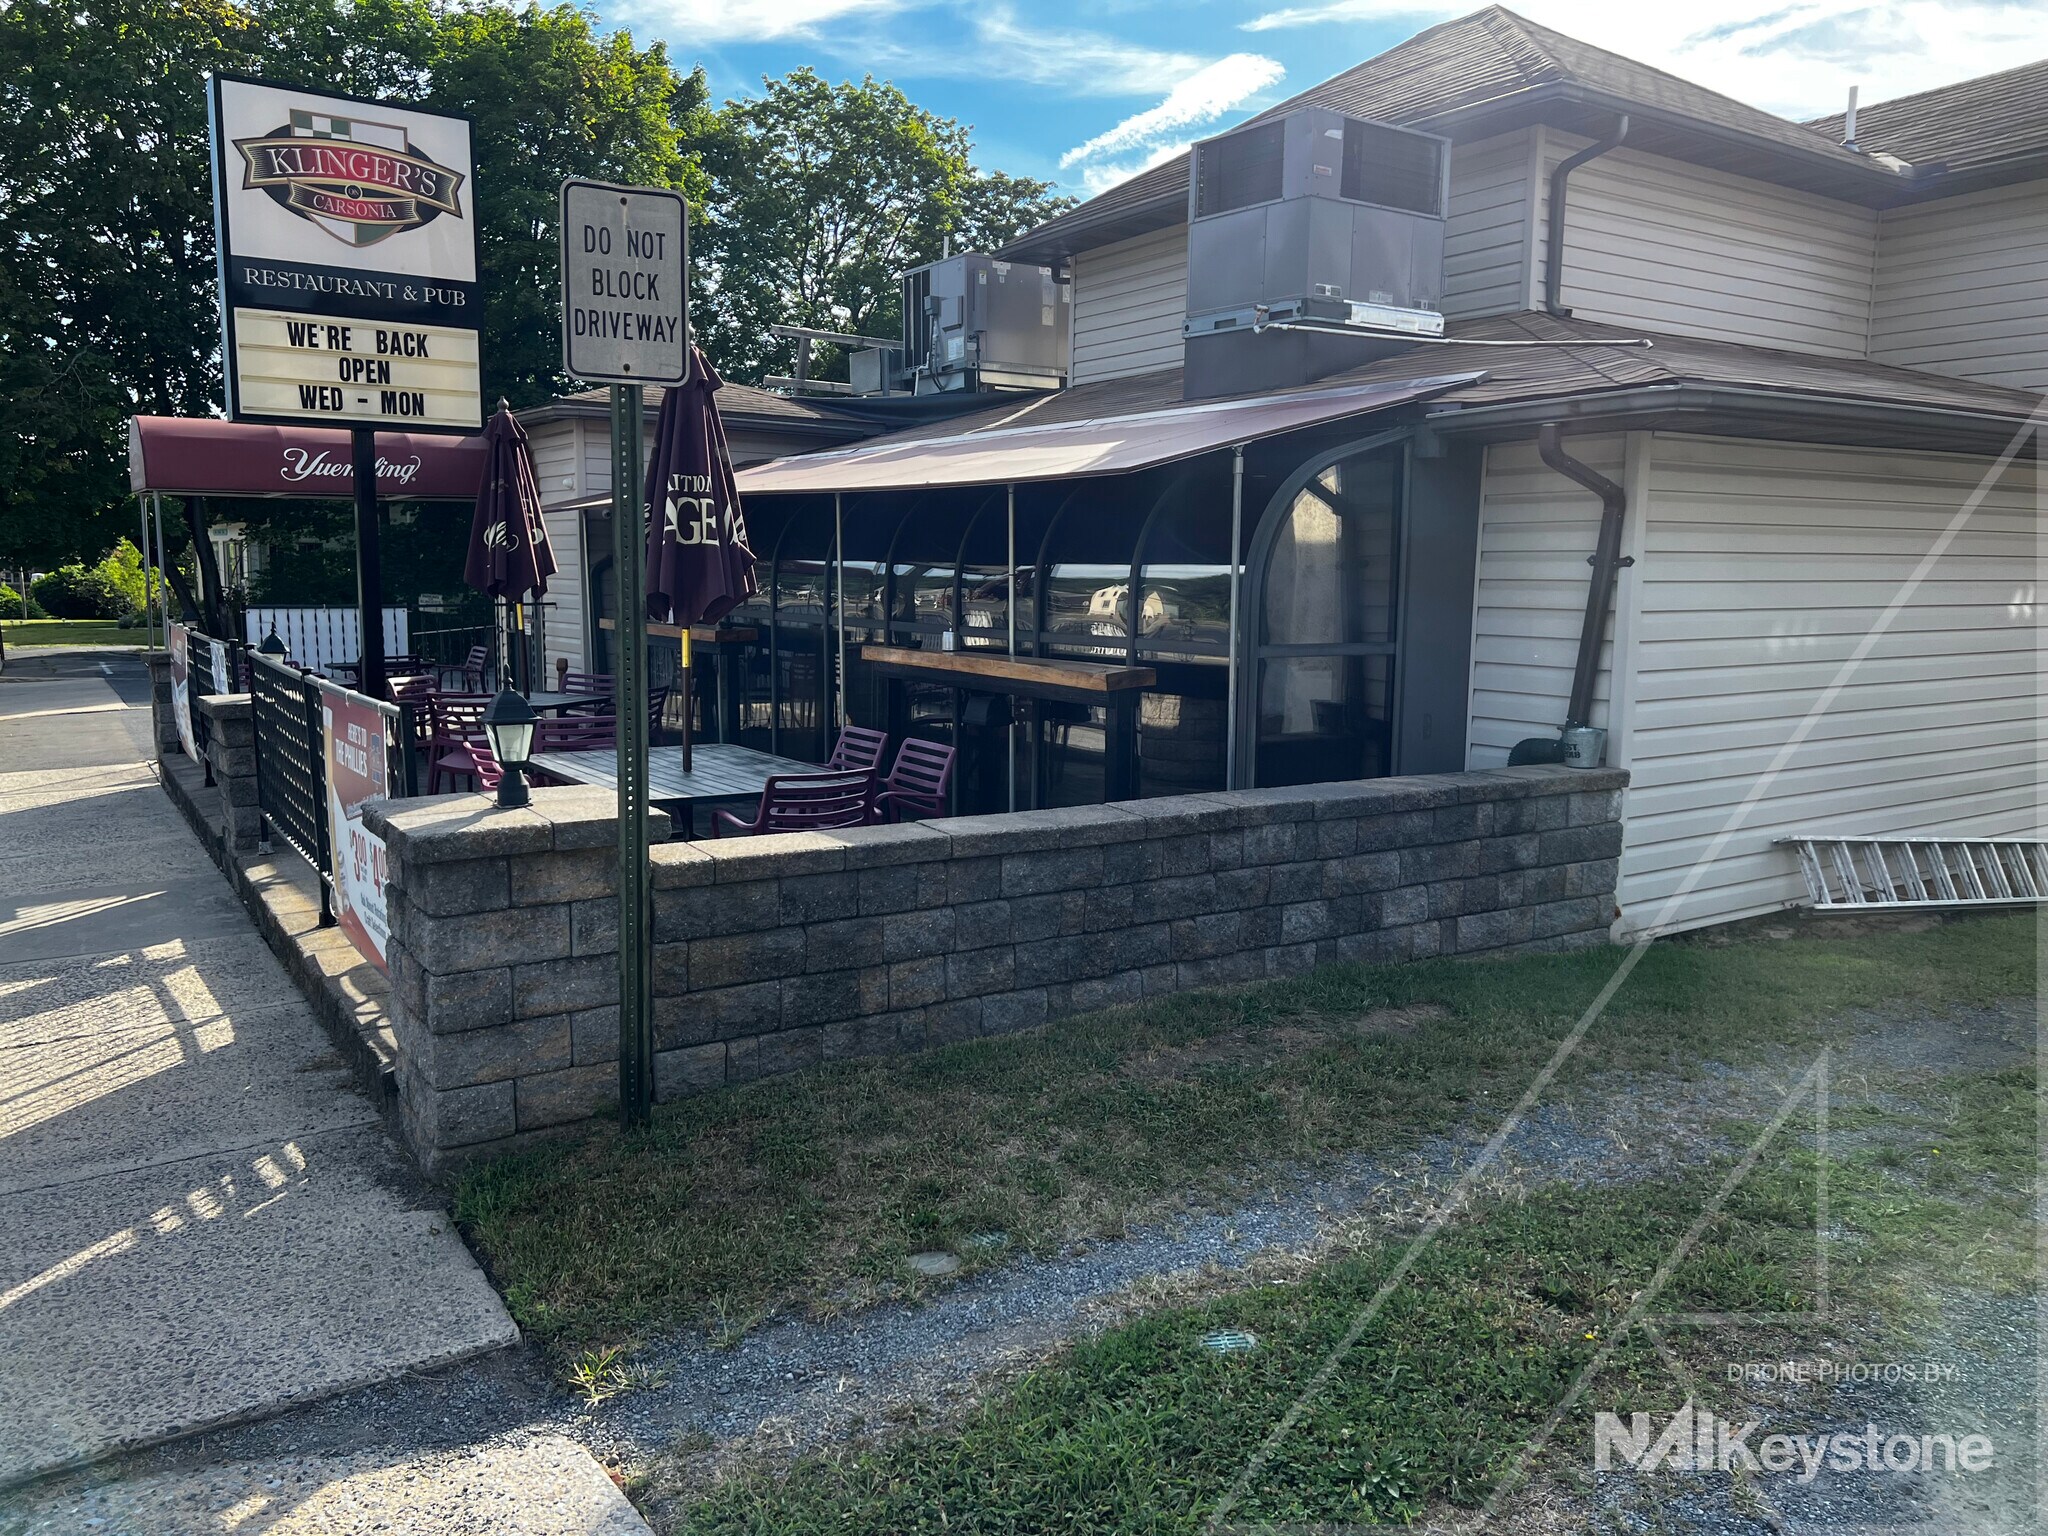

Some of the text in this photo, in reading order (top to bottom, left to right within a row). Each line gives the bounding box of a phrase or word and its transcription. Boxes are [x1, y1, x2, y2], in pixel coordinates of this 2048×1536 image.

[266, 147, 437, 197] KLINGER'S
[313, 195, 397, 219] CARSONIA
[584, 224, 666, 261] DO NOT
[243, 267, 467, 307] RESTAURANT & PUB
[592, 267, 660, 301] BLOCK
[287, 321, 429, 358] WE'RE BACK
[574, 308, 678, 343] DRIVEWAY
[339, 357, 390, 384] OPEN
[299, 385, 344, 412] WED
[381, 391, 425, 417] MON
[281, 447, 421, 485] Yuenling
[662, 496, 719, 546] AGE
